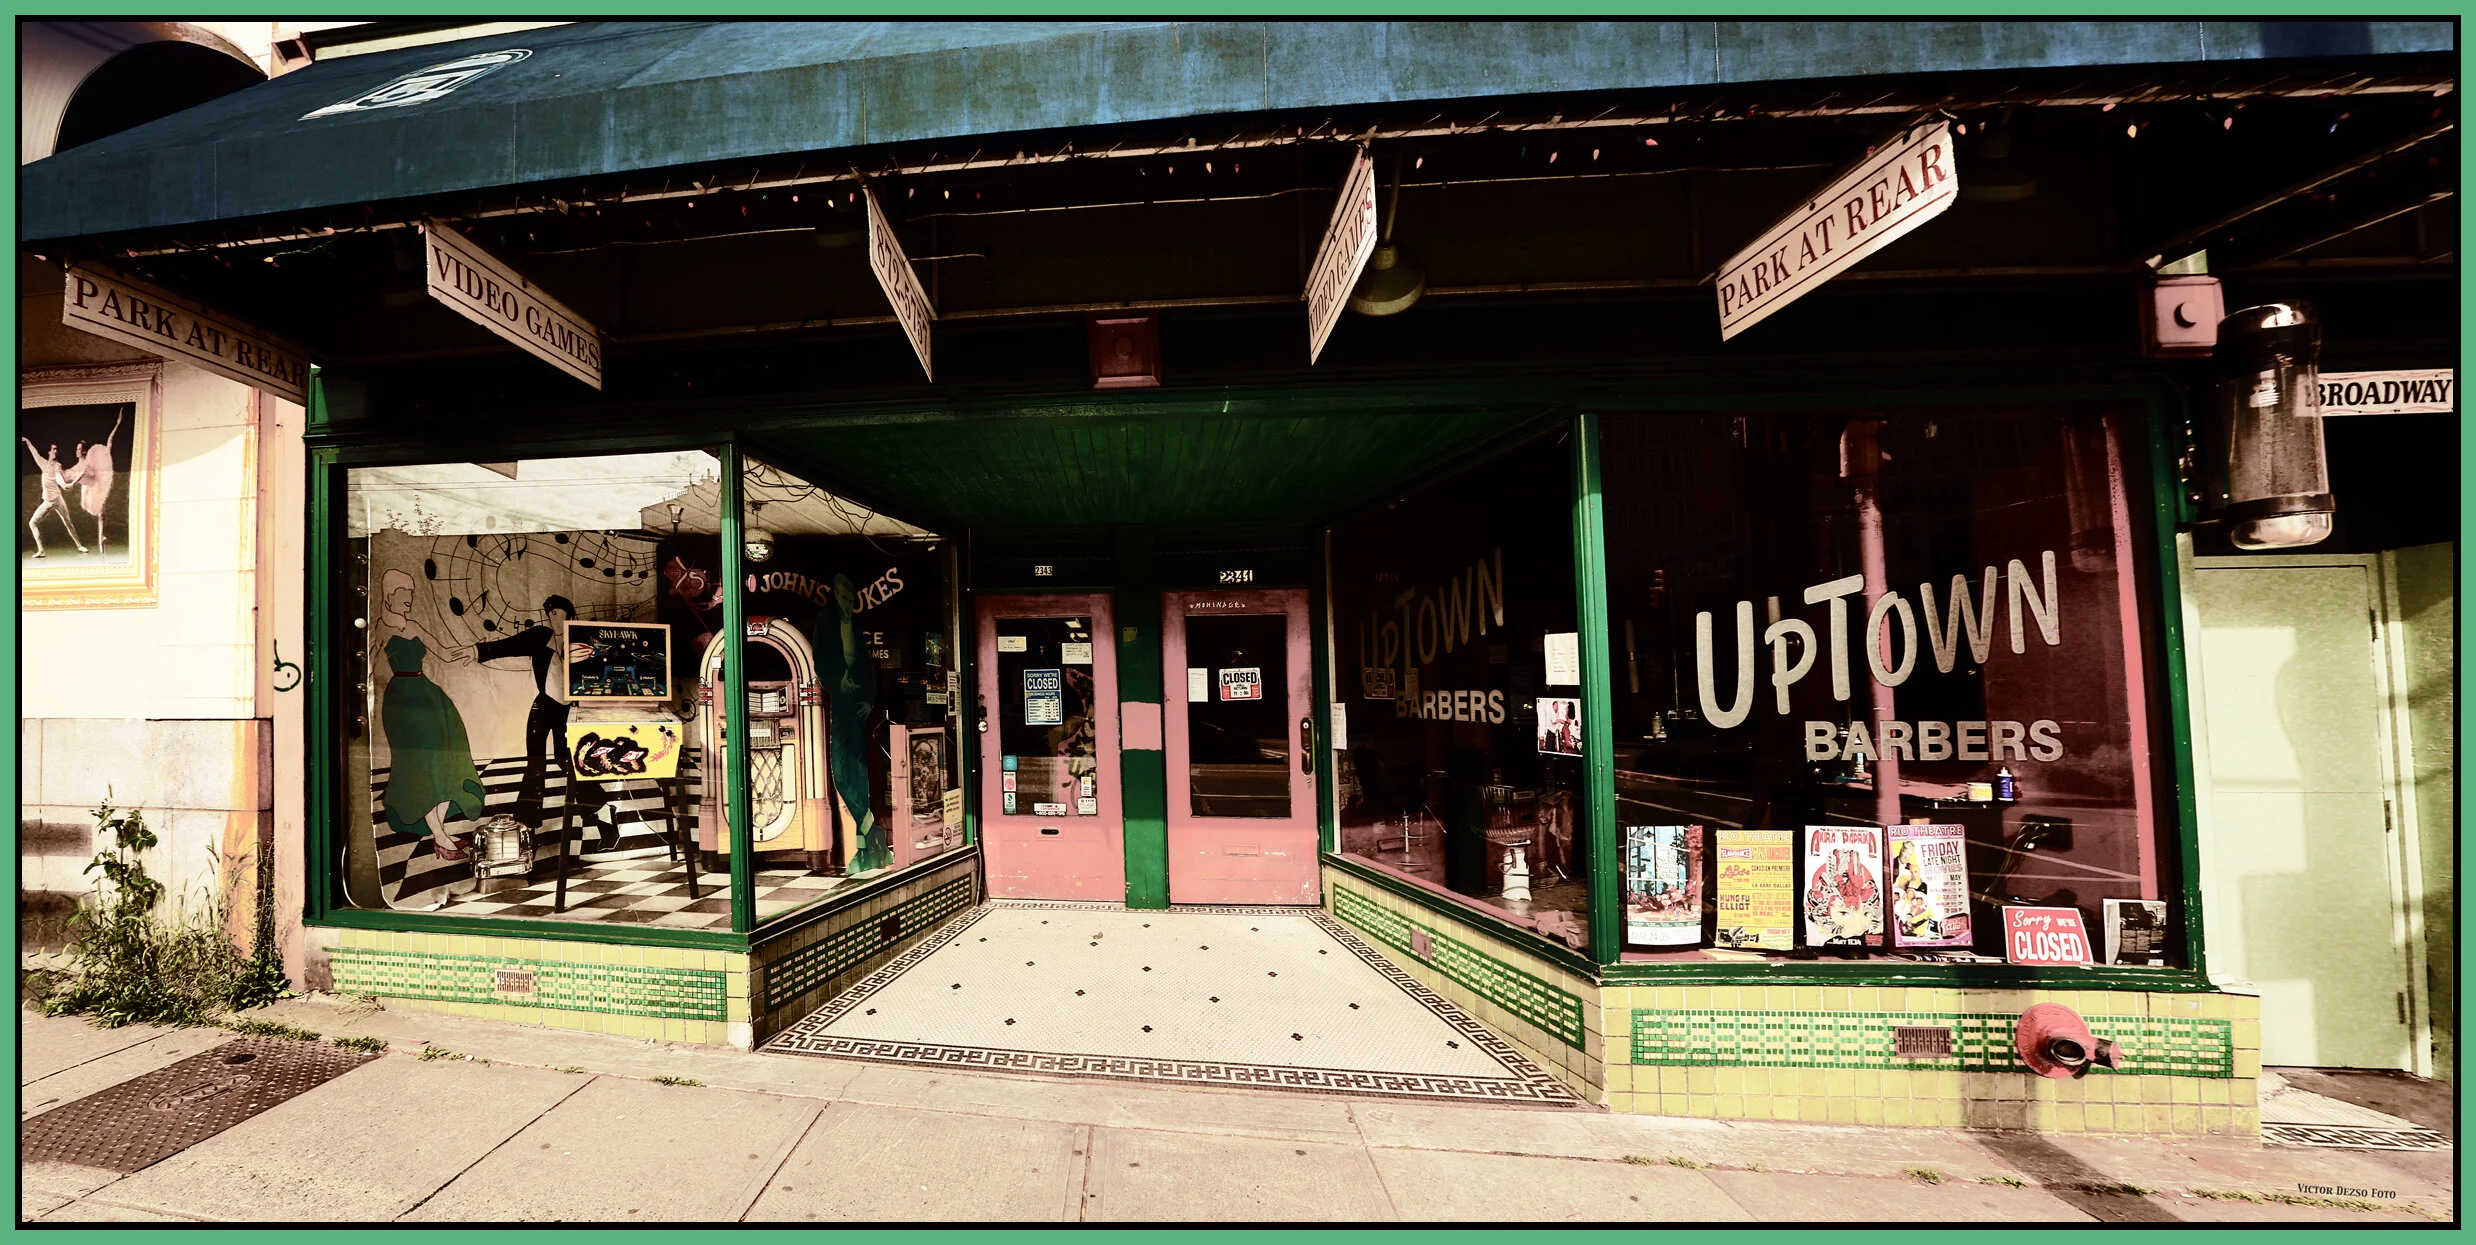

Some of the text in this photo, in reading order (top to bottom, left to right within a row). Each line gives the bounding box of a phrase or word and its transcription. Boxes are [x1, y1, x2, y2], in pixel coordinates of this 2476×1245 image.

[1720, 144, 1947, 318] PARK AT REAR
[1309, 187, 1373, 339] VIDEO GAMES
[432, 244, 600, 372] VIDEO GAMES
[73, 275, 306, 390] PARK AT REAR
[2316, 378, 2453, 408] BROADWAY
[760, 571, 831, 607] JOHN'S
[1027, 677, 1059, 690] CLOSED
[1223, 672, 1257, 685] CLOSED
[1395, 689, 1506, 725] BARBERS
[1804, 719, 2064, 763] BARBERS
[1719, 831, 1791, 841] RIO THEATRE
[1890, 825, 1963, 837] RIO THEATRE
[1921, 841, 1959, 858] FRIDAY
[1923, 855, 1960, 867] LATE NIGHT
[1720, 894, 1740, 902] KUNG
[1741, 894, 1750, 902] FU
[2012, 910, 2052, 931] Sorry
[2014, 931, 2084, 962] CLOSED
